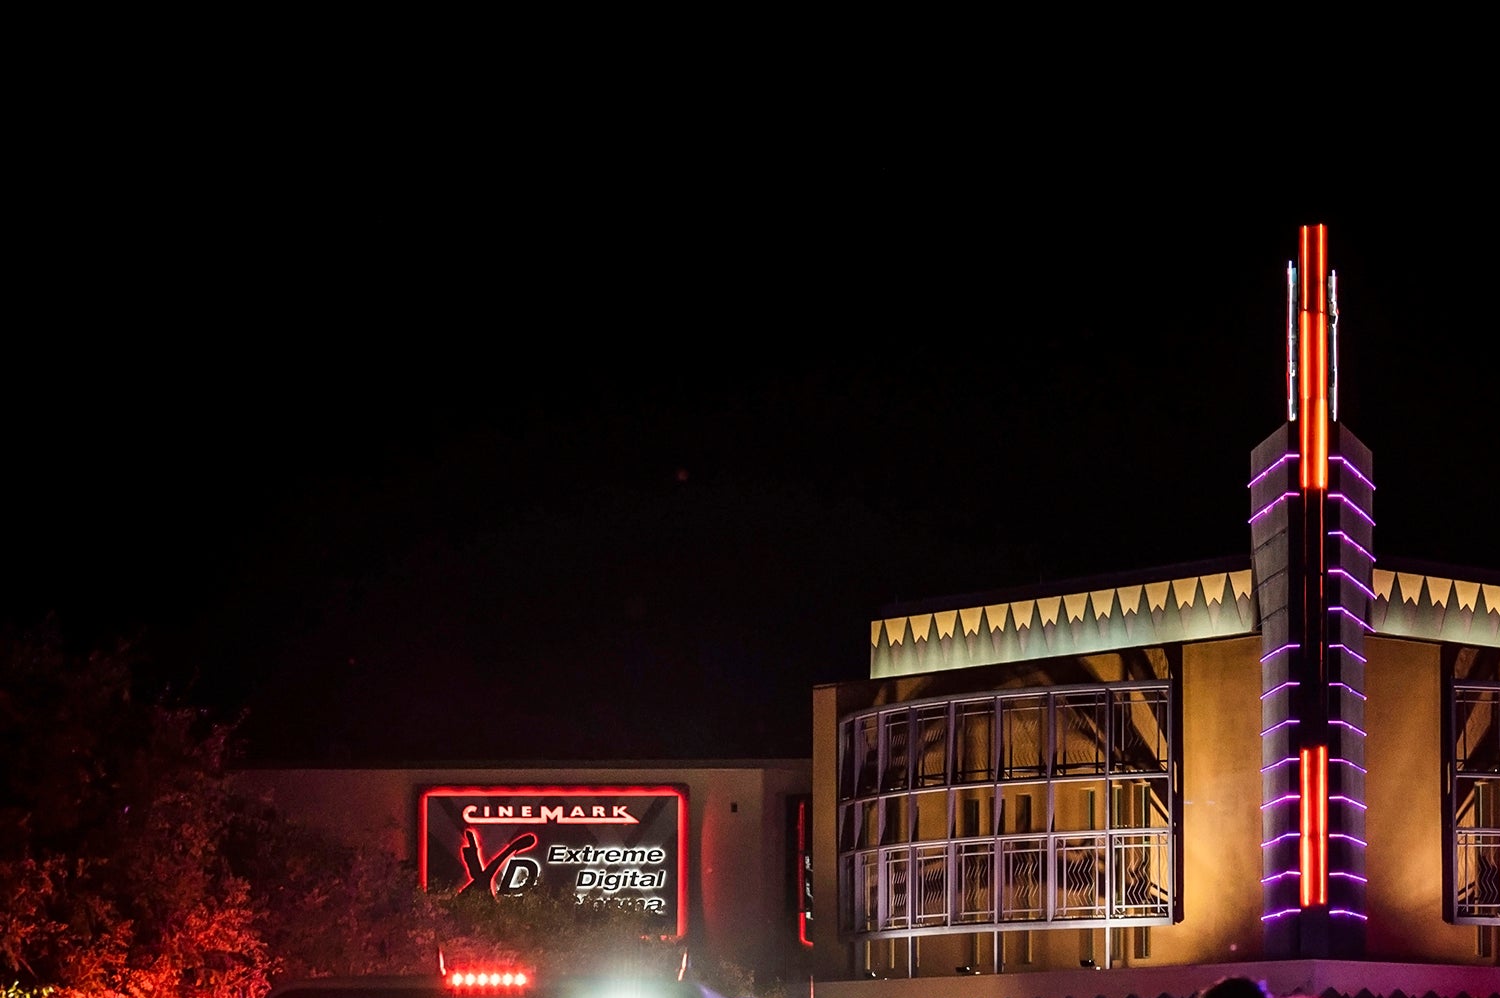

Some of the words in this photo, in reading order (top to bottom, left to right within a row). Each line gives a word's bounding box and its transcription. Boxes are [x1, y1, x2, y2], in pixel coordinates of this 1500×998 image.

[462, 805, 640, 824] CINEMARK
[547, 846, 665, 864] Extreme
[576, 870, 666, 891] Digital
